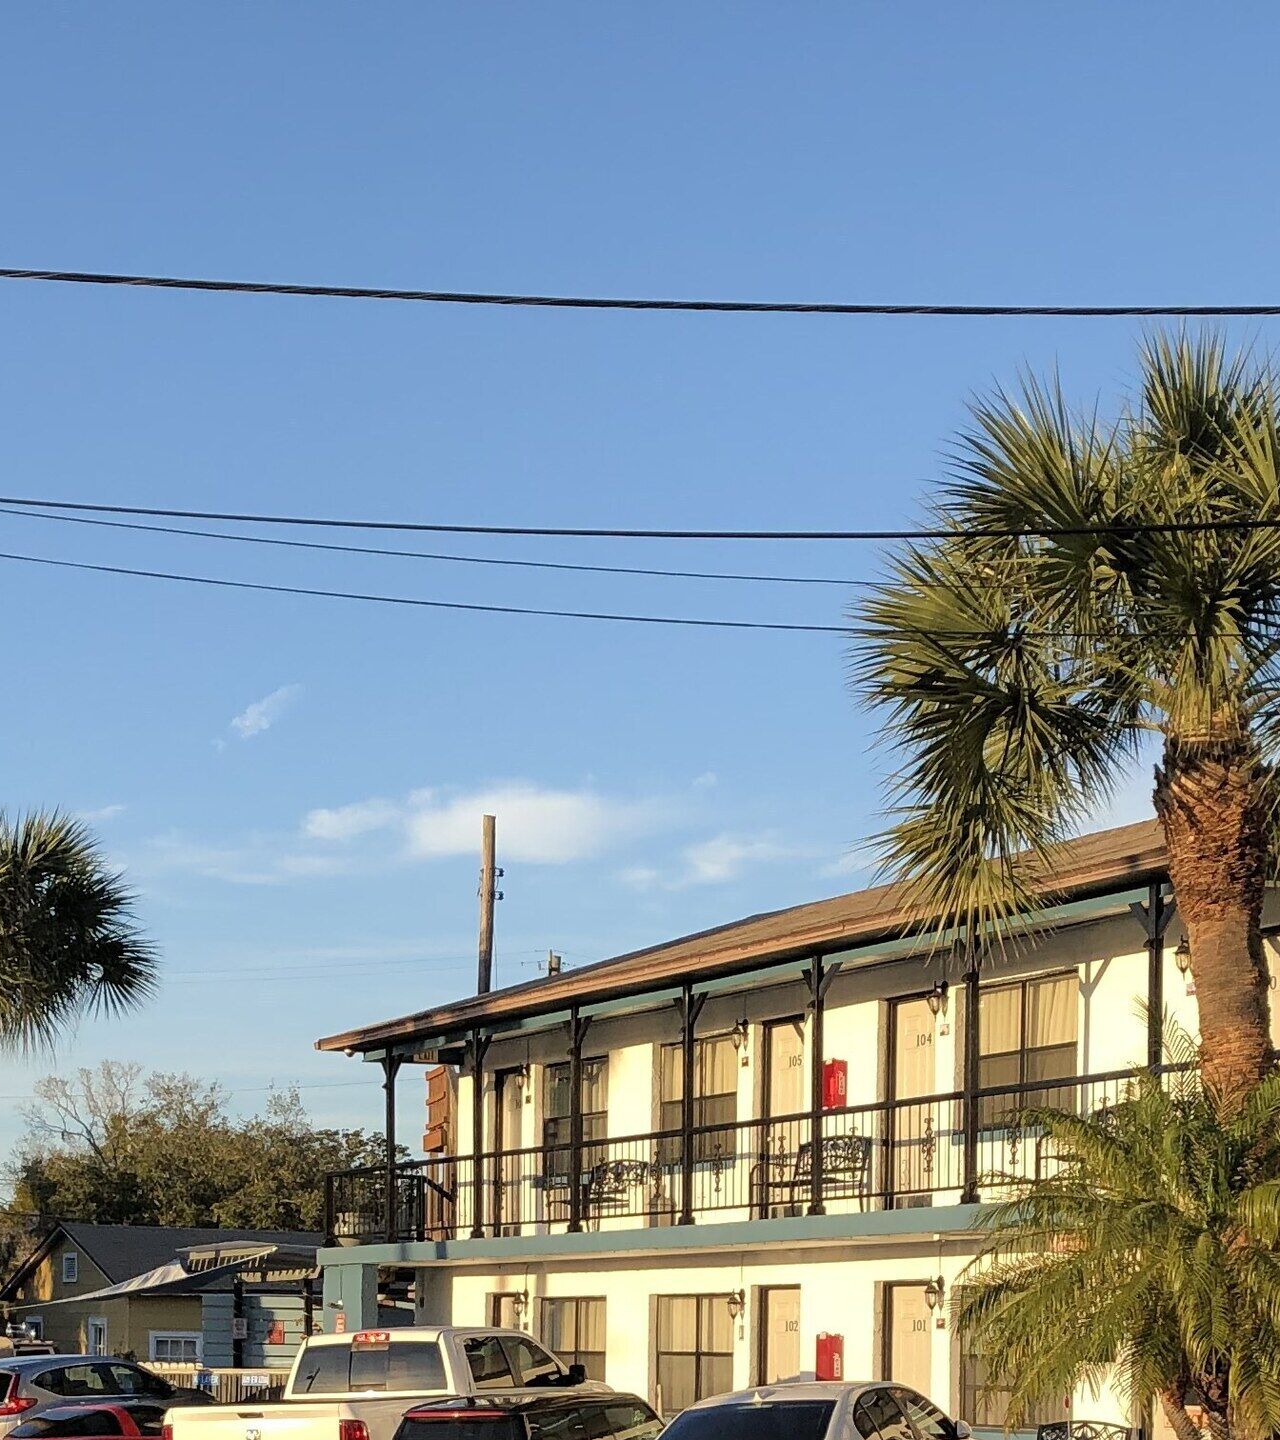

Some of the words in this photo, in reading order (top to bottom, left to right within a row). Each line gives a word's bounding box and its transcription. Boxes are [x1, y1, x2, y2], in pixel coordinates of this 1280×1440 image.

[916, 1032, 932, 1047] 104
[788, 1054, 803, 1068] 105
[785, 1320, 799, 1332] 102
[912, 1319, 927, 1332] 101
